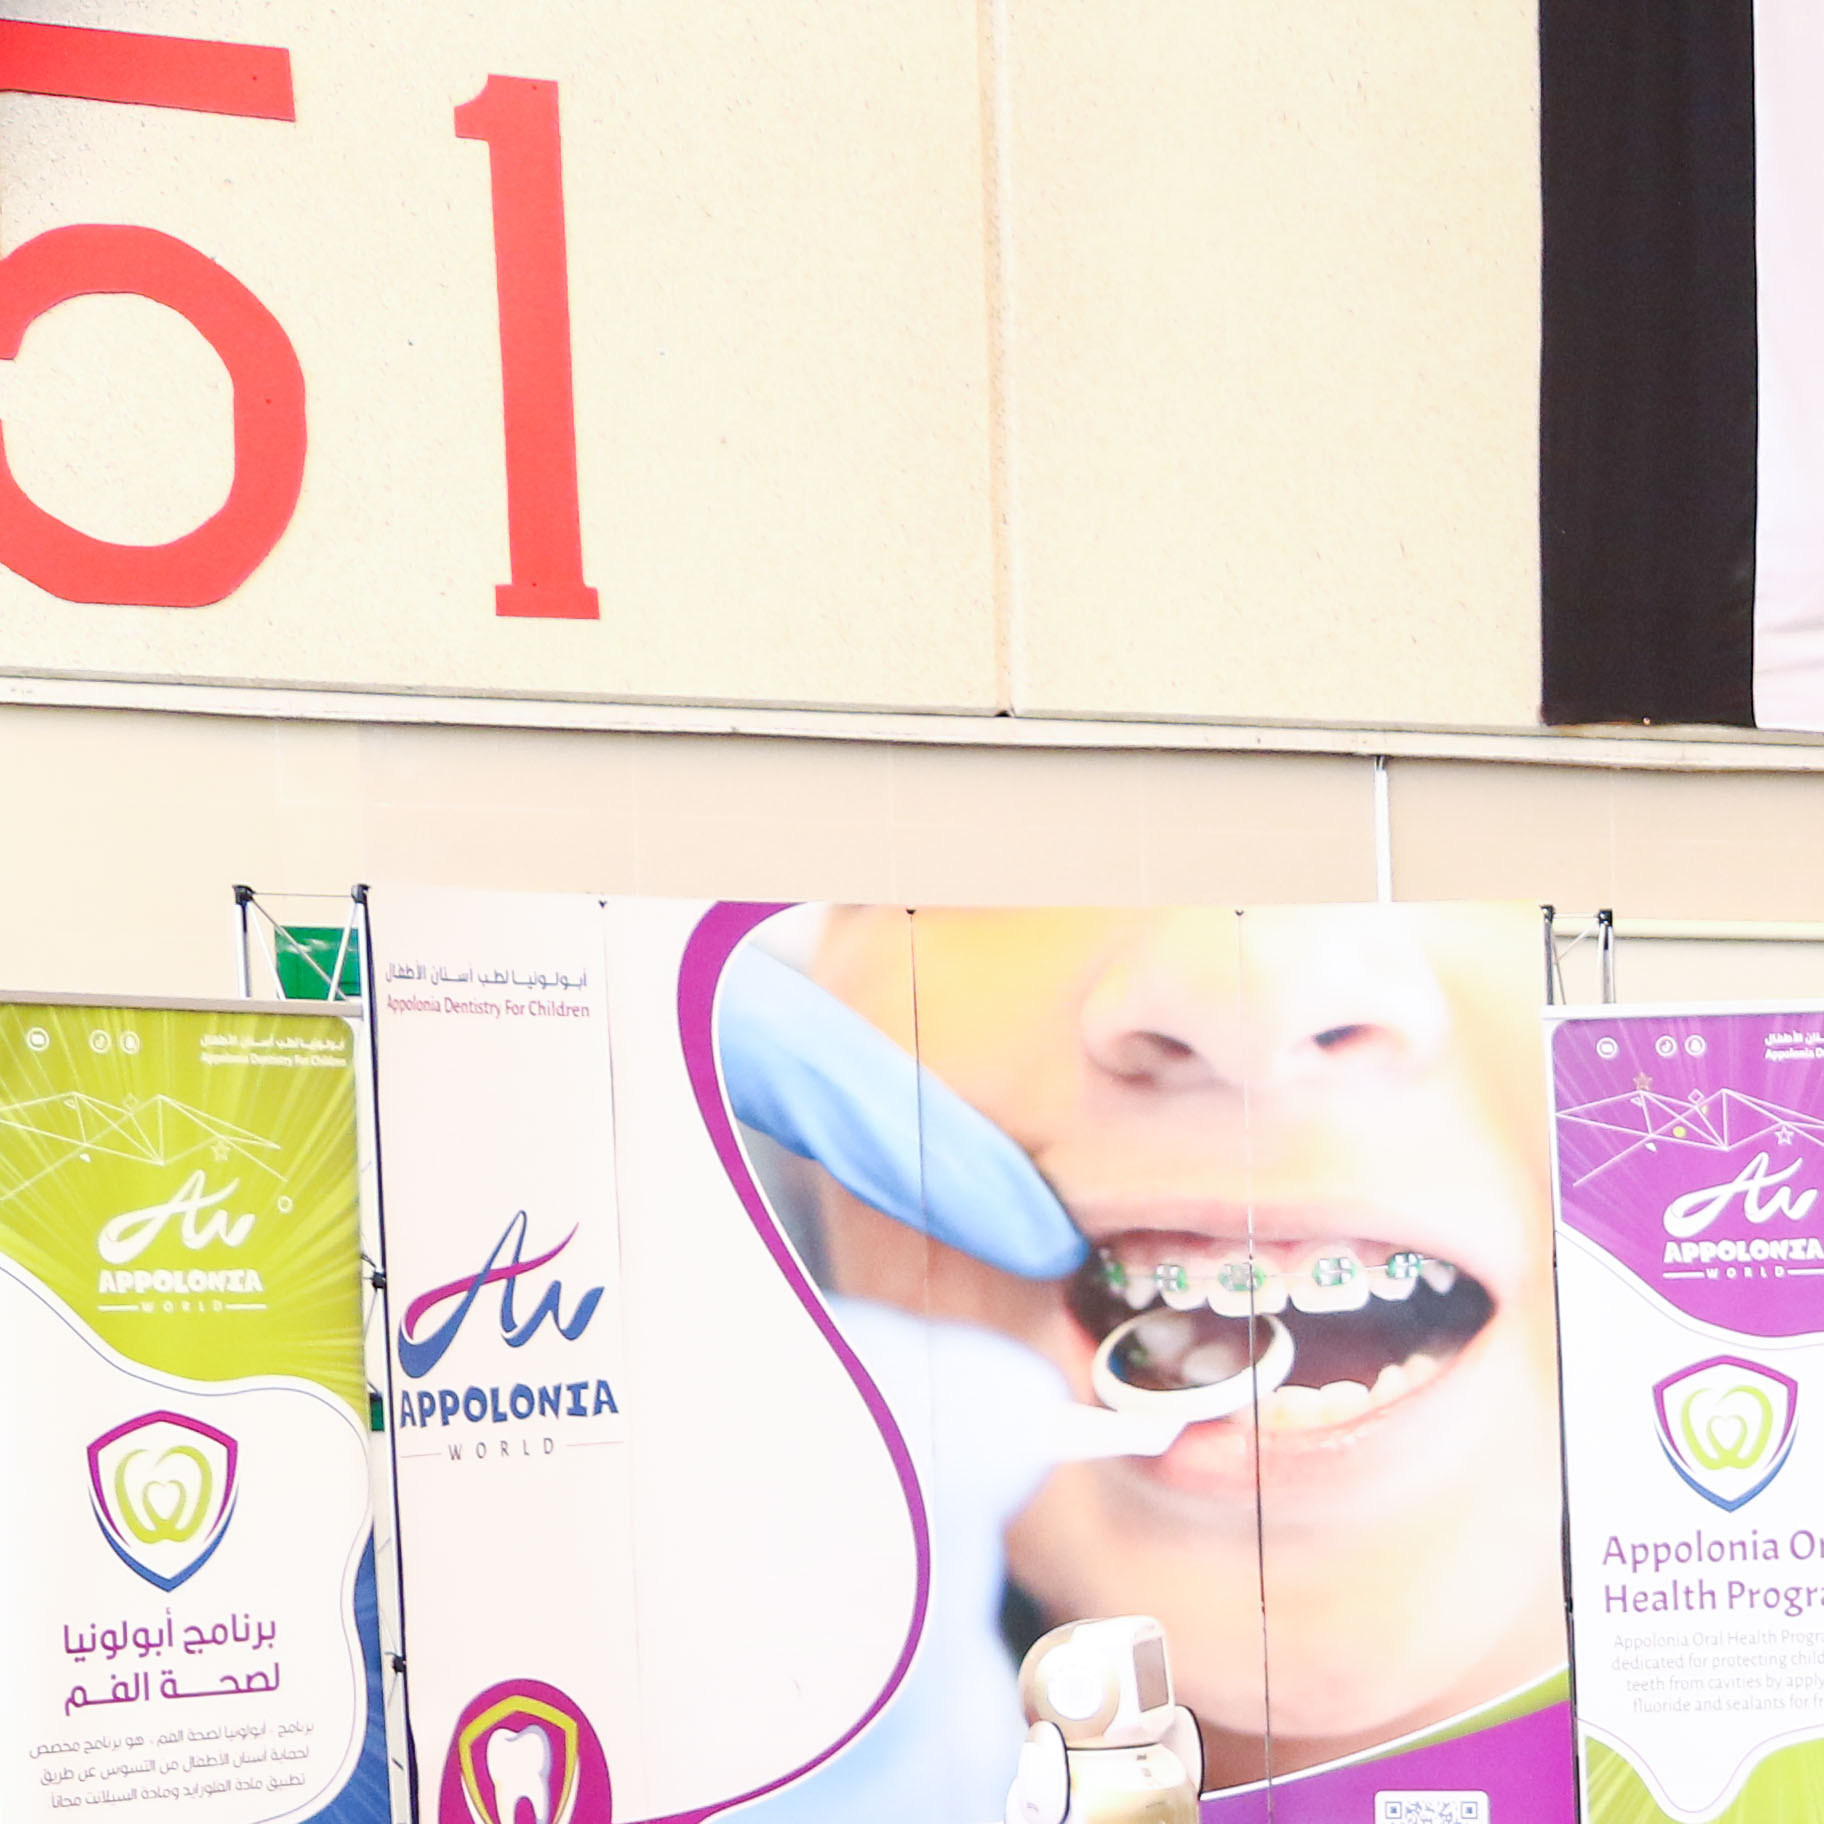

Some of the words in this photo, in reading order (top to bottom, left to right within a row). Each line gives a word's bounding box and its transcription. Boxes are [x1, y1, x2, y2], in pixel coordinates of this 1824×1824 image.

[387, 993, 441, 1015] Appolonia
[444, 997, 501, 1018] Dentistry
[506, 999, 526, 1016] For
[528, 999, 590, 1018] Children
[98, 1268, 264, 1294] APPOLONIA
[1705, 1265, 1785, 1280] WORLD
[400, 1379, 619, 1428] APPOLONIA
[448, 1437, 554, 1461] WORLD
[1602, 1529, 1779, 1574] Appolonia
[1604, 1578, 1717, 1614] Health
[64, 1607, 173, 1663] أبولونيا
[184, 1613, 276, 1654] برنامج
[1613, 1632, 1689, 1651] Appolonia
[1692, 1631, 1723, 1647] Oral
[1727, 1629, 1778, 1646] Health
[1610, 1654, 1684, 1671] dedicated
[1688, 1652, 1708, 1669] for
[1712, 1652, 1788, 1670] protecting
[160, 1662, 280, 1699] لصحة
[1626, 1676, 1665, 1692] teeth
[1669, 1674, 1704, 1691] from
[1707, 1674, 1762, 1690] cavities
[1766, 1673, 1783, 1691] by
[64, 1672, 150, 1717] الفم
[1633, 1696, 1691, 1713] fluoride
[1694, 1696, 1722, 1711] and
[1725, 1694, 1786, 1711] sealants
[1789, 1692, 1810, 1709] for
